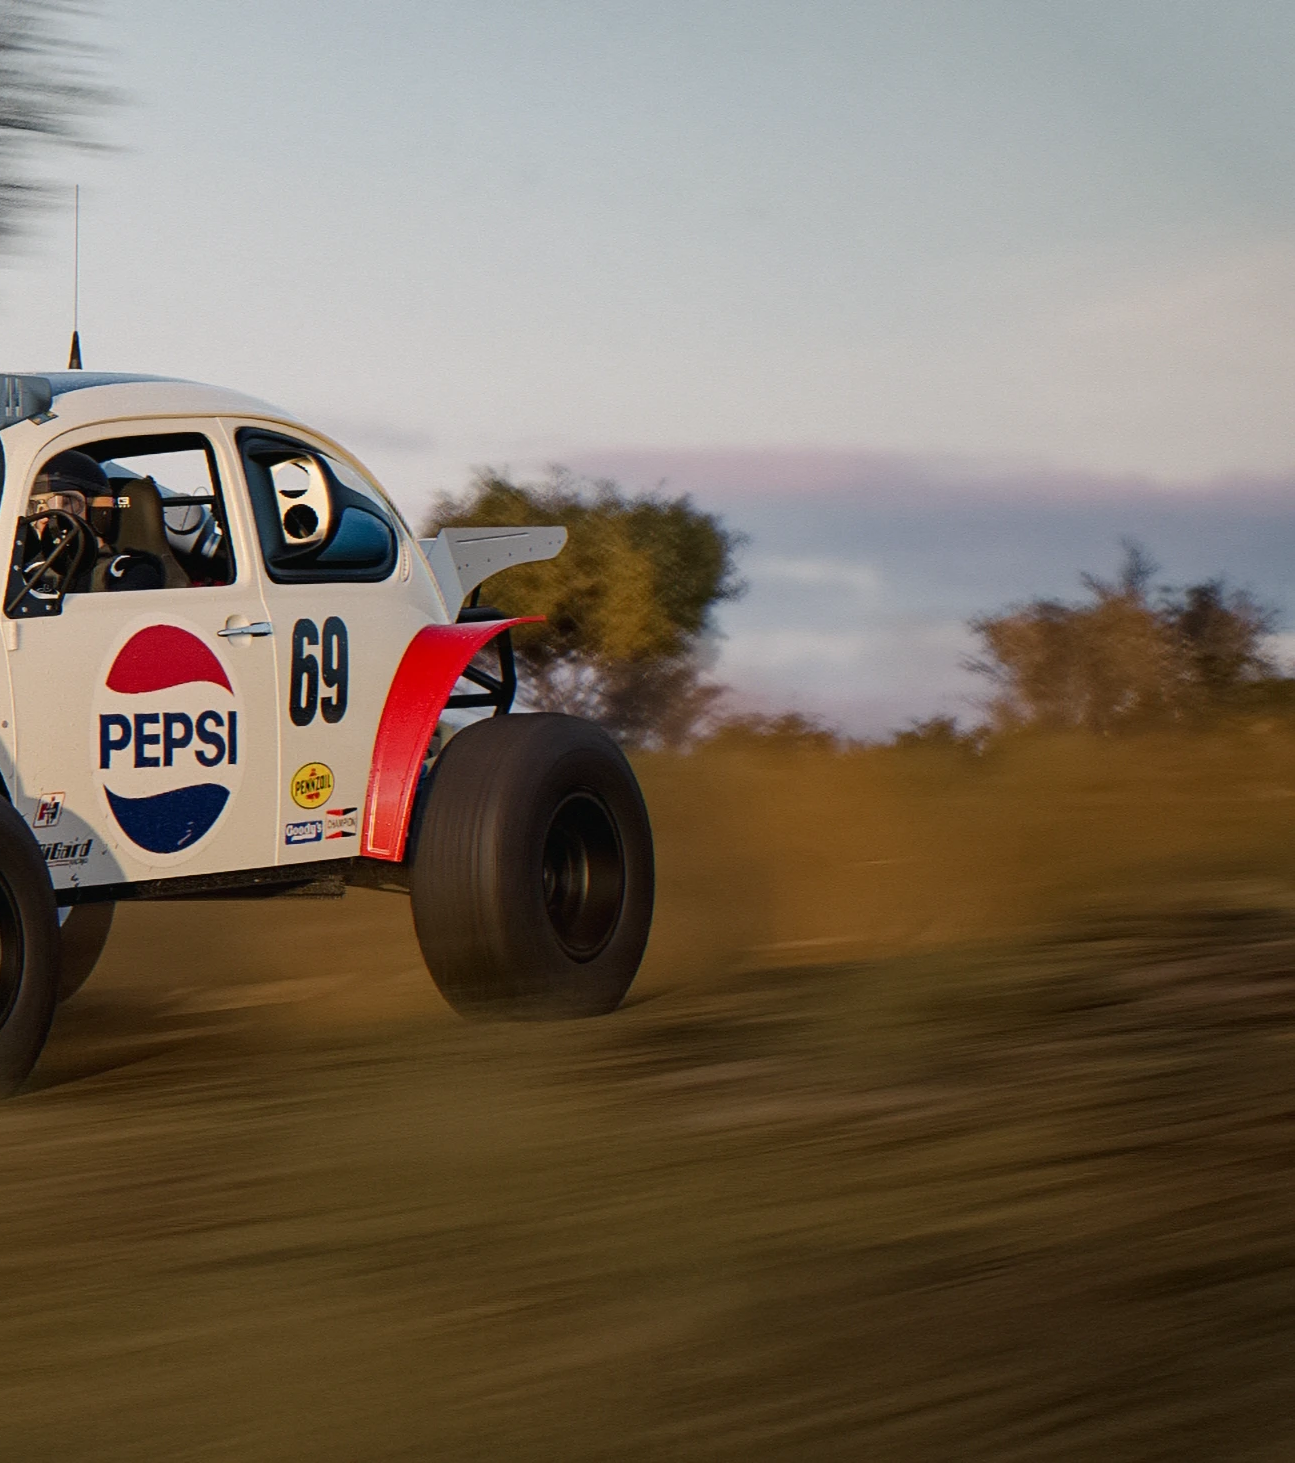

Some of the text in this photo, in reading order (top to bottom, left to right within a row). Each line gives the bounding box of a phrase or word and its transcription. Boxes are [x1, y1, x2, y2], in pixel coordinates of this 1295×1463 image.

[289, 616, 349, 726] 69
[99, 710, 238, 769] PEPSI
[295, 774, 332, 797] PENNZOIL
[286, 822, 323, 842] Goody's
